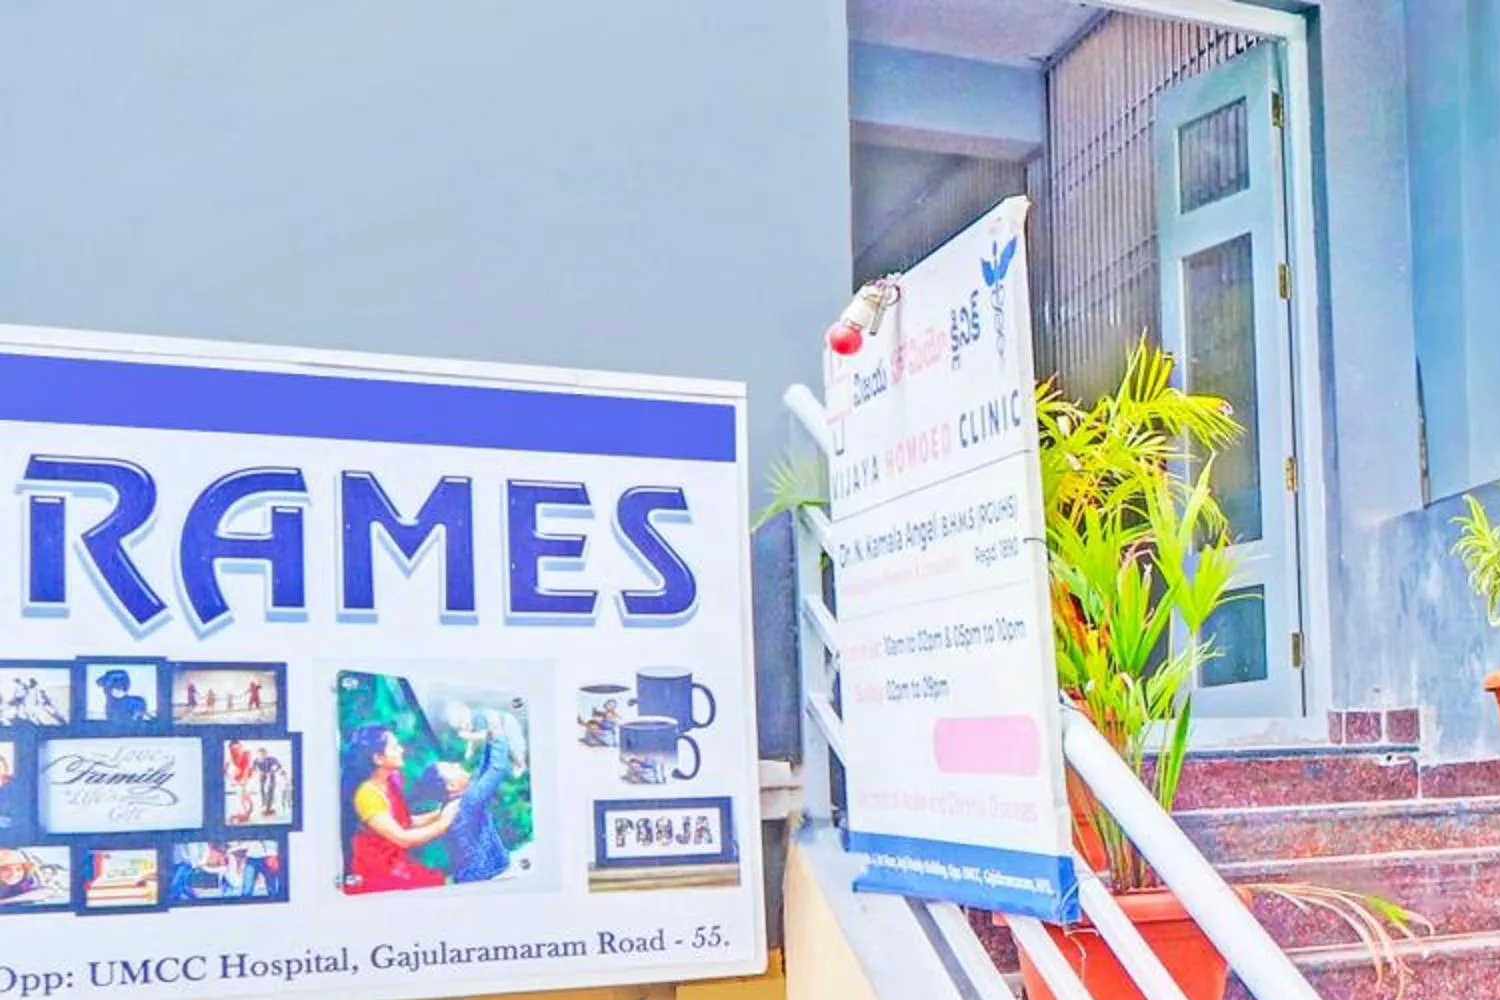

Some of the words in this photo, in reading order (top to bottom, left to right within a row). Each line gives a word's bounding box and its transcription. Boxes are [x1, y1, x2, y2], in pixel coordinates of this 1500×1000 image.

[958, 389, 1022, 448] CLINIC
[16, 453, 701, 641] RAMES
[89, 955, 208, 987] UMCC
[218, 947, 359, 980] Hospital,
[370, 940, 588, 972] Gajularamaram
[596, 929, 666, 954] Road
[690, 925, 731, 949] 55.
